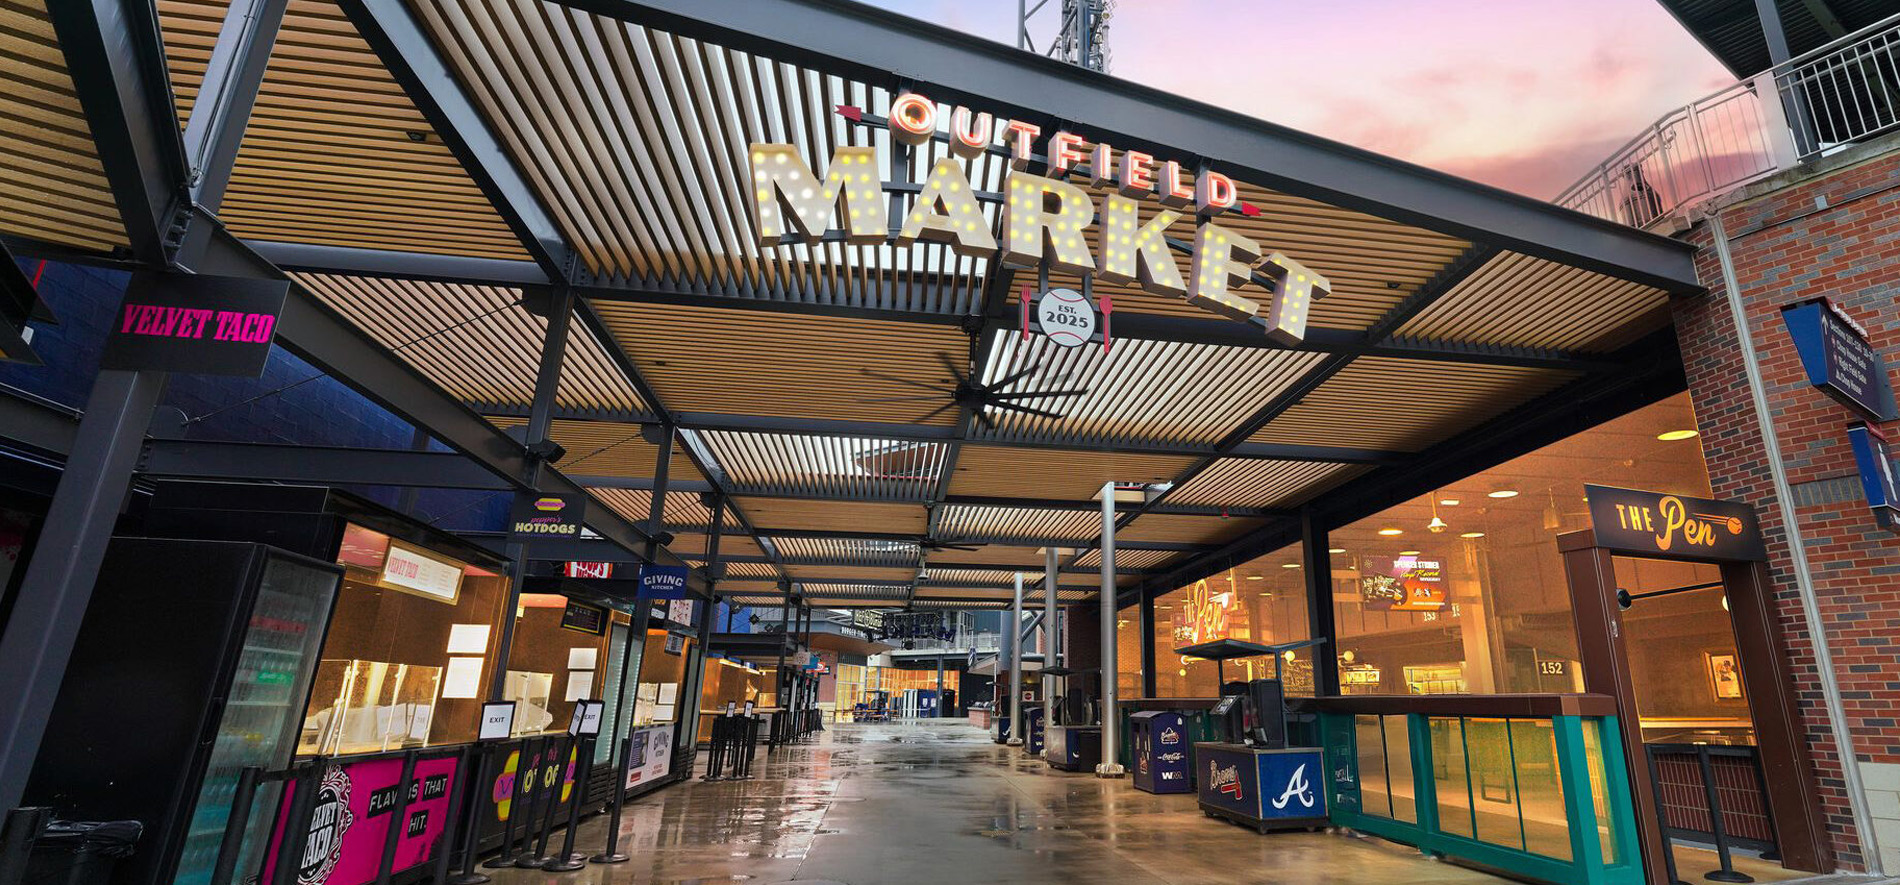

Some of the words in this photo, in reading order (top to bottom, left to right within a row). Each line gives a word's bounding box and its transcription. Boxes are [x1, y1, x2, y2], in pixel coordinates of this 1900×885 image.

[889, 93, 1237, 215] OUTFIELD
[750, 143, 1331, 346] MARKET
[1058, 303, 1077, 315] EST.
[121, 304, 214, 339] VELVET
[213, 311, 275, 343] TACO
[1046, 311, 1089, 330] 2025
[515, 522, 576, 534] HOTDOGS
[1616, 504, 1653, 532] THE
[1656, 496, 1716, 550] Pen
[643, 574, 684, 587] GIVING
[1191, 579, 1226, 644] Pen
[1541, 662, 1563, 675] 152
[1162, 771, 1181, 780] WM
[424, 777, 448, 796] THAT
[408, 814, 428, 834] HIT.
